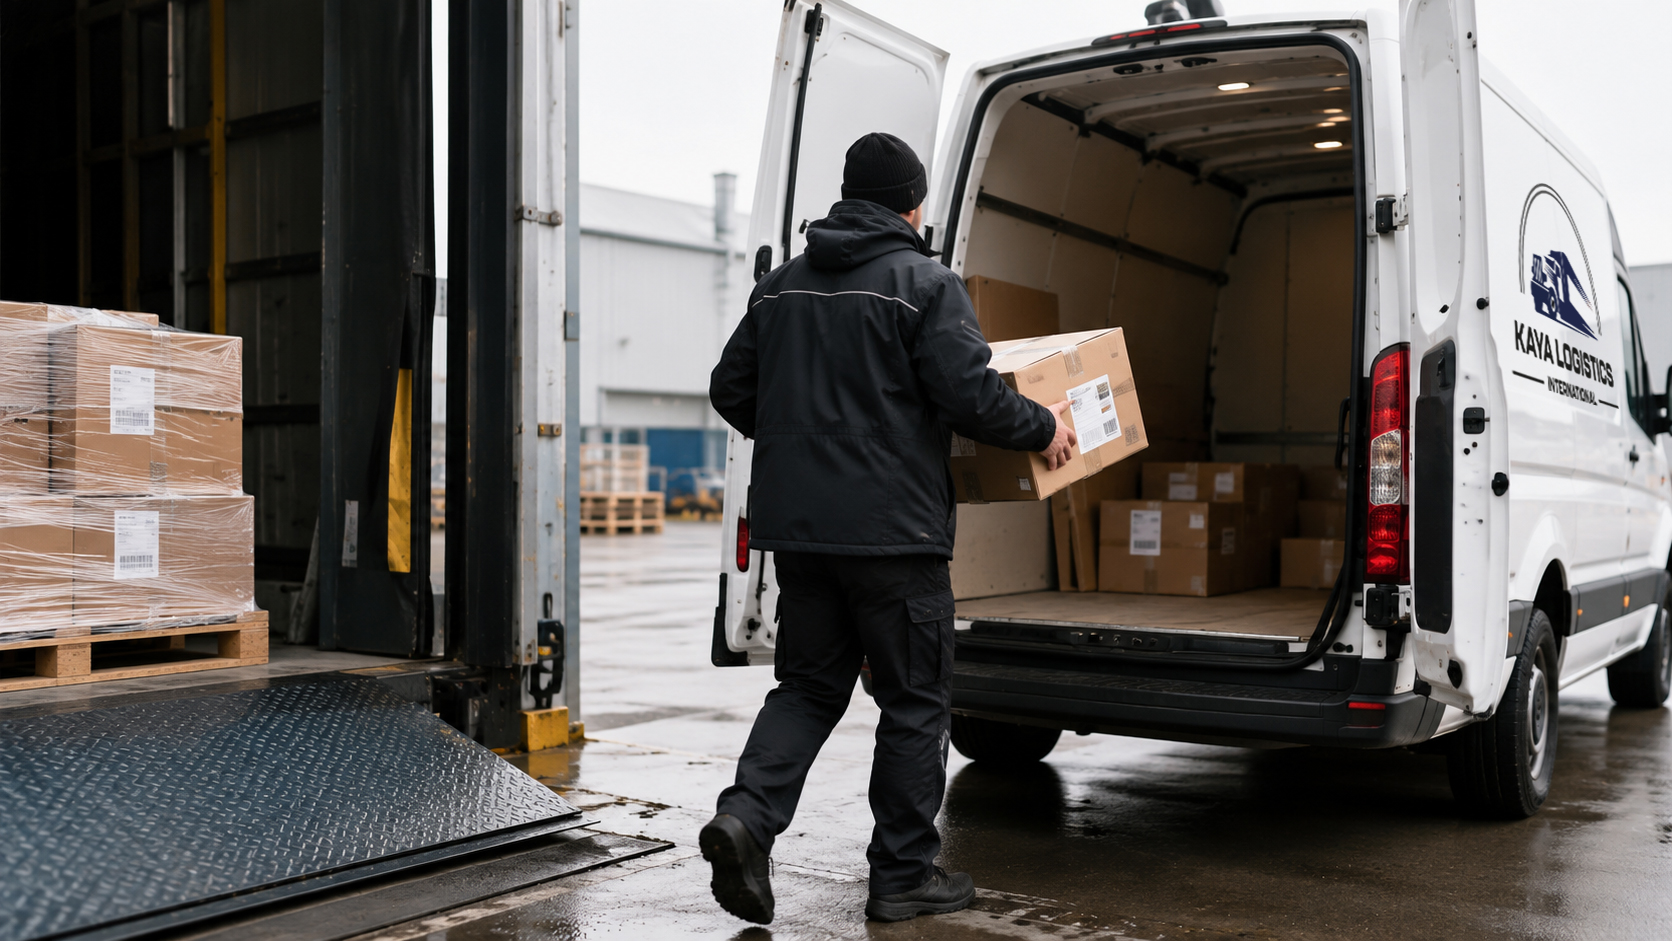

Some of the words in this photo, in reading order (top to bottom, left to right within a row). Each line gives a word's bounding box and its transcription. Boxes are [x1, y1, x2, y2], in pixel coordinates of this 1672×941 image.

[1514, 320, 1554, 364] KAYA
[1555, 338, 1614, 388] LOGISTICS
[1547, 376, 1598, 406] INTERNATIONAL
